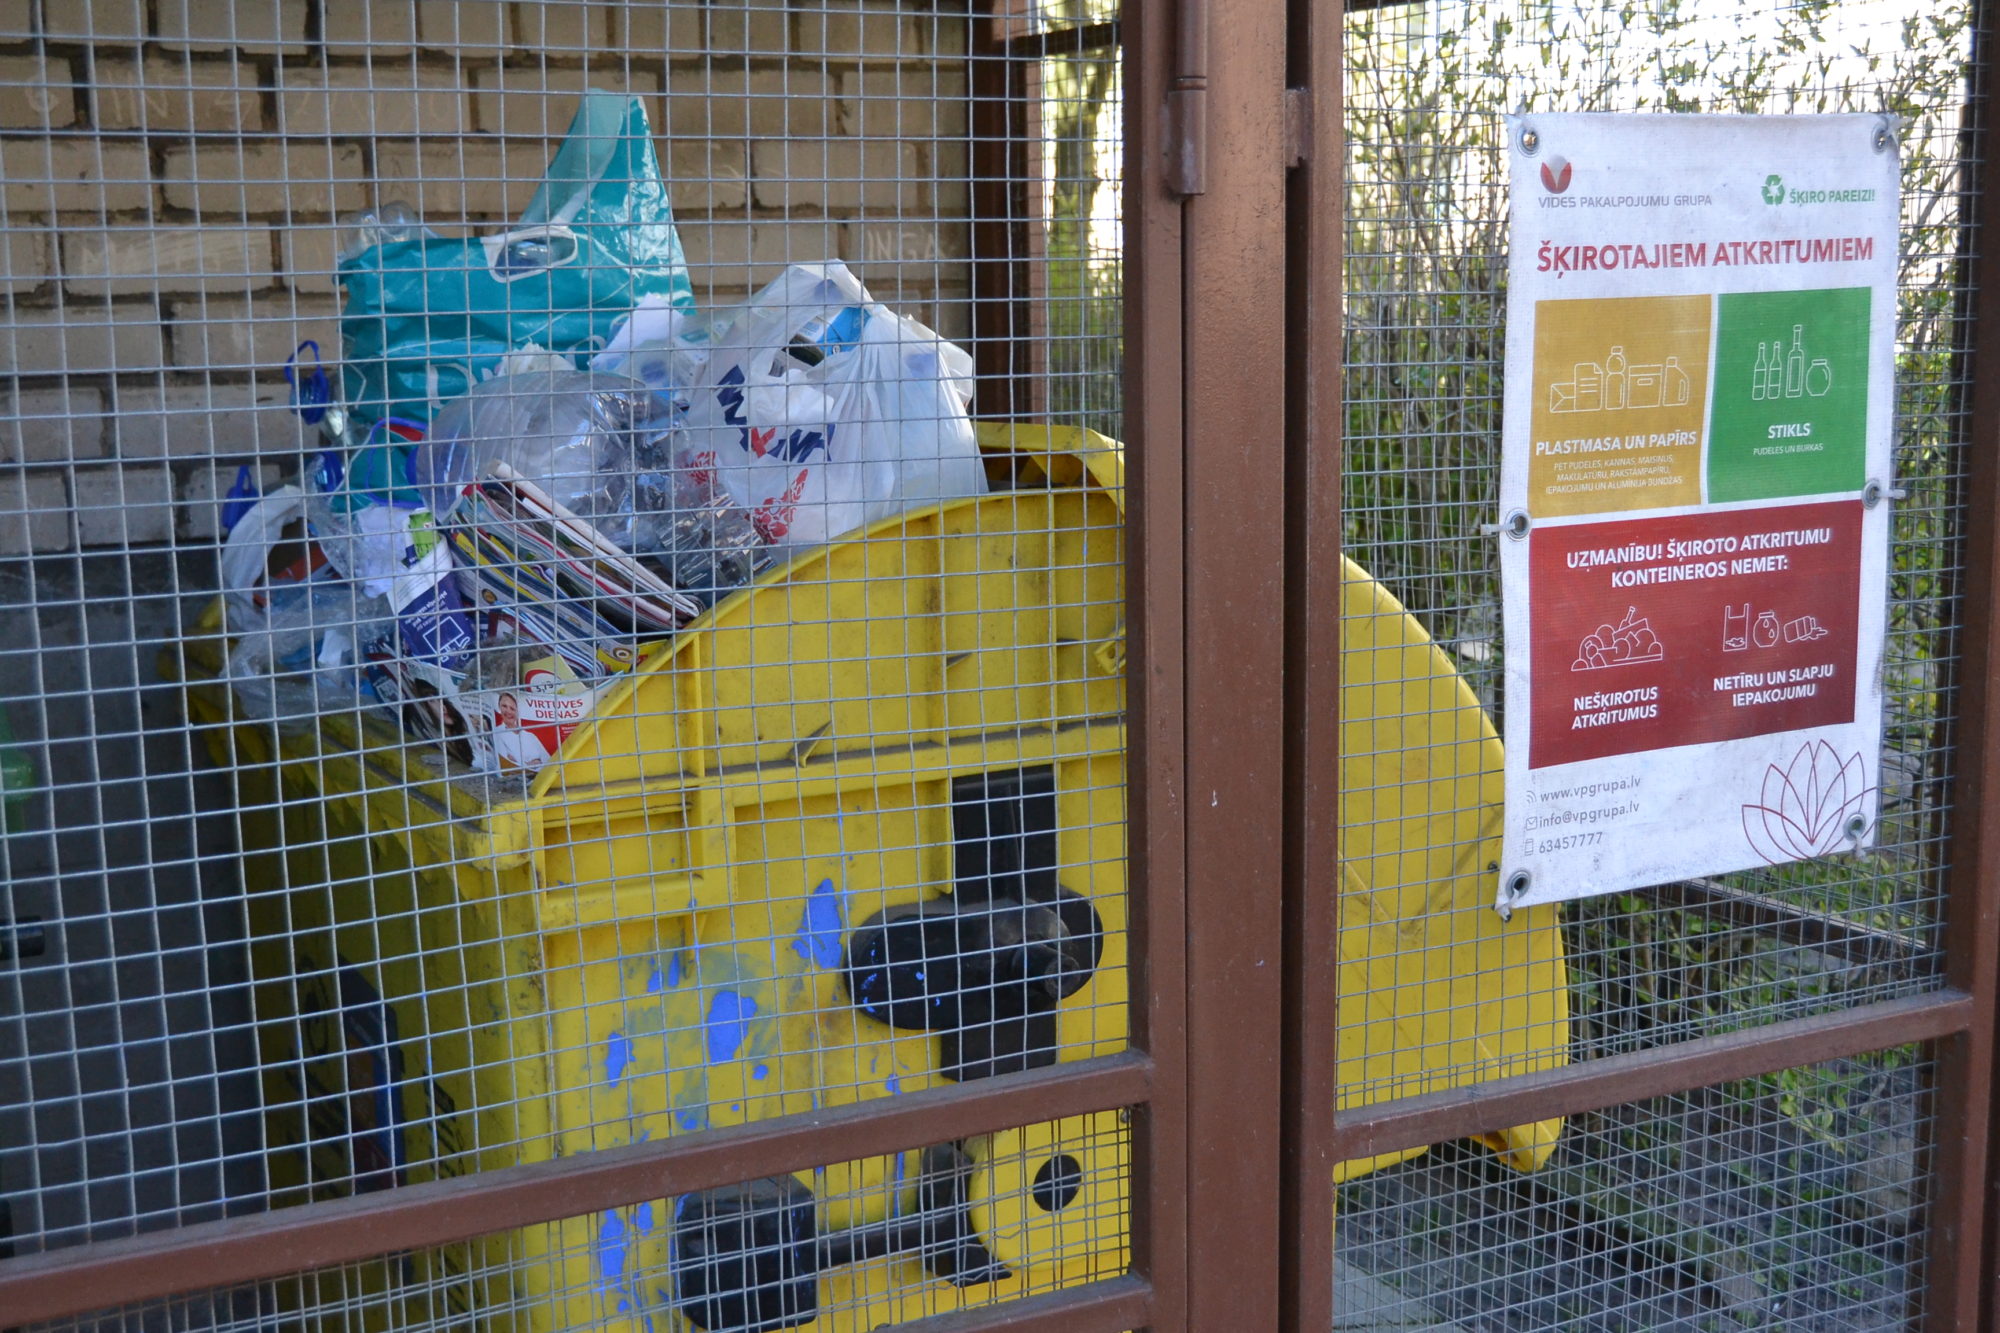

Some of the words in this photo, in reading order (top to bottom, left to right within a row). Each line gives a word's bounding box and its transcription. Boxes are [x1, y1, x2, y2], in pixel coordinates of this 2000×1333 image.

[1538, 196, 1576, 208] VIDES
[1580, 195, 1670, 208] PAKALPOJUMU
[1673, 194, 1712, 206] GRUPA
[1789, 189, 1825, 207] ŠĶIRO
[1828, 189, 1875, 203] PAREIZI!
[1537, 240, 1707, 279] ŠĶIROTAJIEM
[1712, 237, 1873, 267] ATKRITUMIEM
[1536, 436, 1621, 456] PLASTMASA
[1624, 434, 1645, 451] UN
[1648, 429, 1697, 448] PAPĪRS
[1768, 422, 1811, 439] STIKLS
[1753, 446, 1783, 456] PUDELES
[1784, 445, 1795, 454] UN
[1566, 541, 1663, 569] UZMANĪBU!
[1666, 536, 1737, 562] ŠĶIROTO
[1740, 528, 1831, 552] ATKRITUMU
[1611, 562, 1728, 588] KONTEINEROS
[1730, 556, 1789, 576] NEMET:
[1713, 671, 1764, 692] NETĪRU
[1766, 670, 1786, 686] UN
[1788, 664, 1834, 684] SLAPJU
[526, 698, 584, 709] VIRTUVES
[1574, 686, 1659, 712] NEŠĶIROTUS
[1732, 684, 1816, 708] IEPAKOJUMU
[536, 710, 580, 719] DIENAS
[1571, 704, 1658, 730] ATKRITUMUS
[1540, 774, 1642, 803] www.vpgrupa.lv
[1538, 800, 1640, 829] info@vpgrupa.lv
[1538, 832, 1604, 854] 63457777
